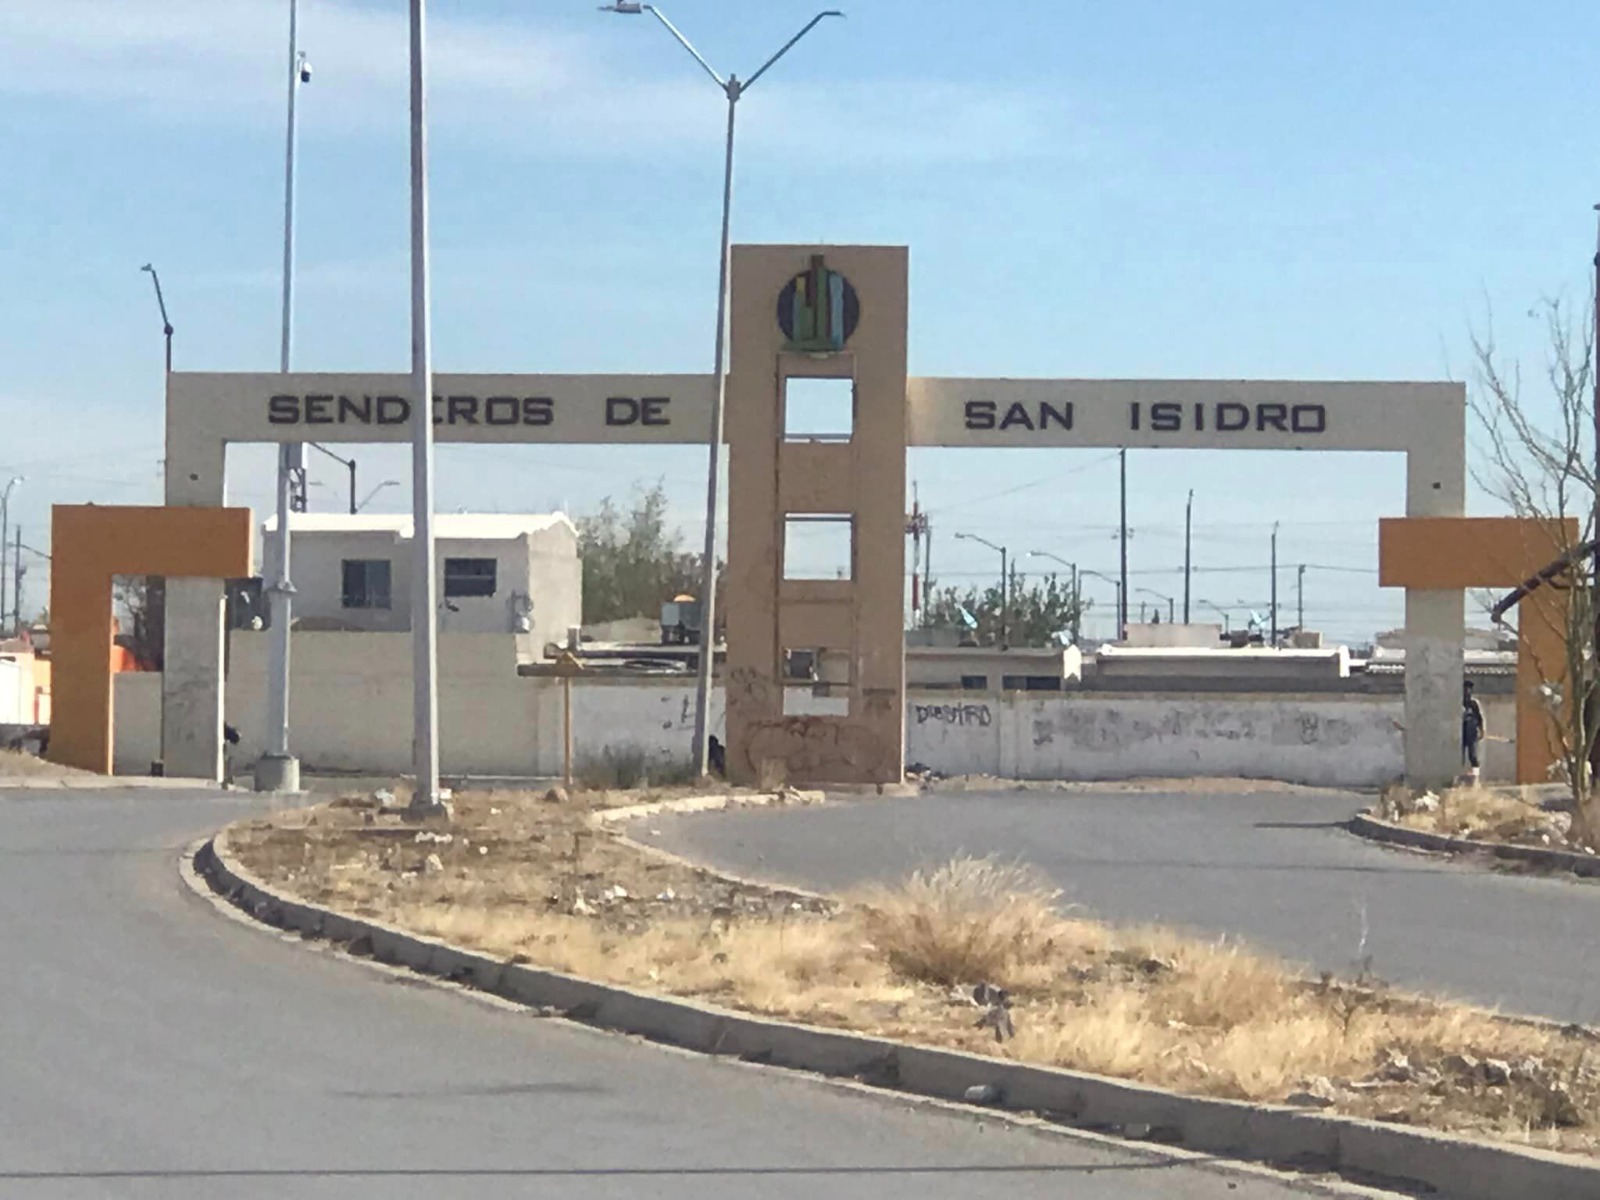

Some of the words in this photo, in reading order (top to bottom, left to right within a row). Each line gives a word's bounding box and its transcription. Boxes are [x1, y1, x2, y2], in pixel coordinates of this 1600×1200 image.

[606, 397, 671, 426] DE
[965, 401, 1074, 431] SAN
[1131, 402, 1325, 433] ISIDRO
